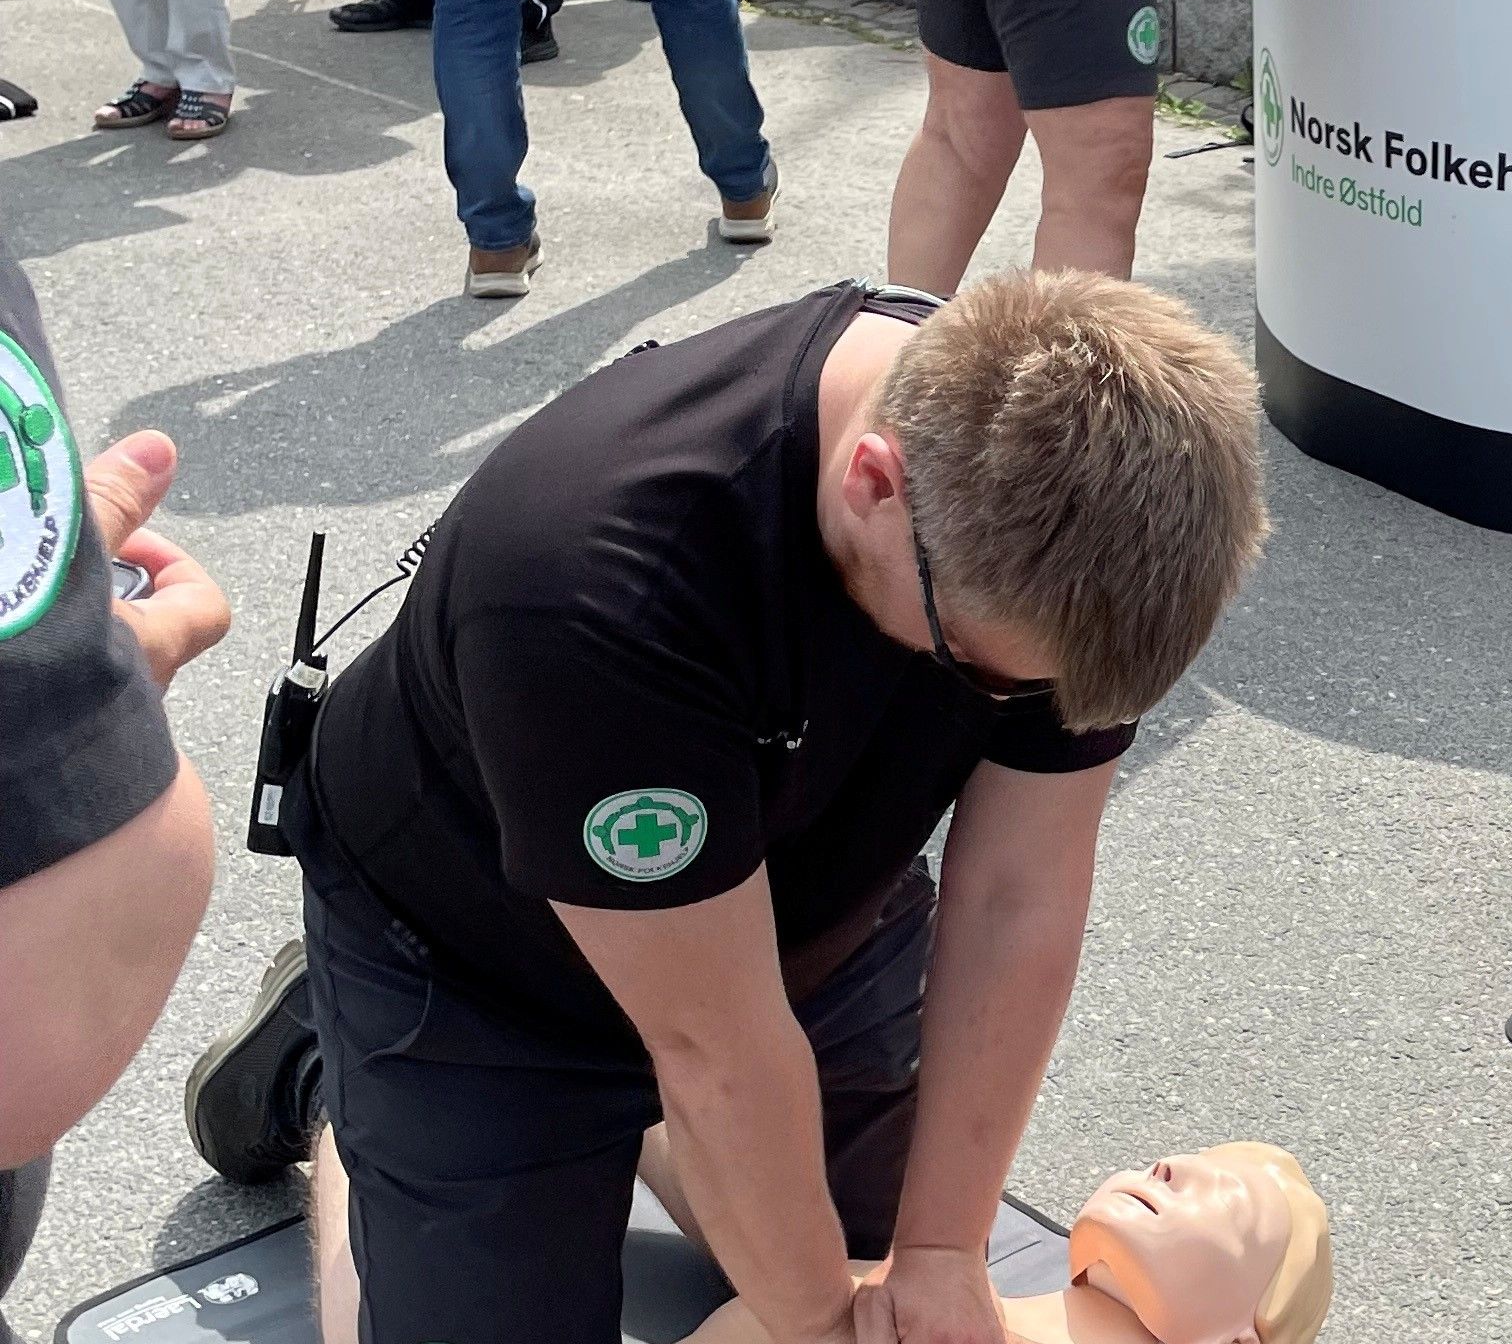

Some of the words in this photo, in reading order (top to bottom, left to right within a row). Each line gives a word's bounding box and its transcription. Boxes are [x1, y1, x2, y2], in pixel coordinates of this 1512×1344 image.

[1290, 96, 1374, 164] Norsk
[1291, 154, 1335, 199] Indre
[1339, 176, 1424, 228] Østfold
[103, 1296, 202, 1342] Laerdal
